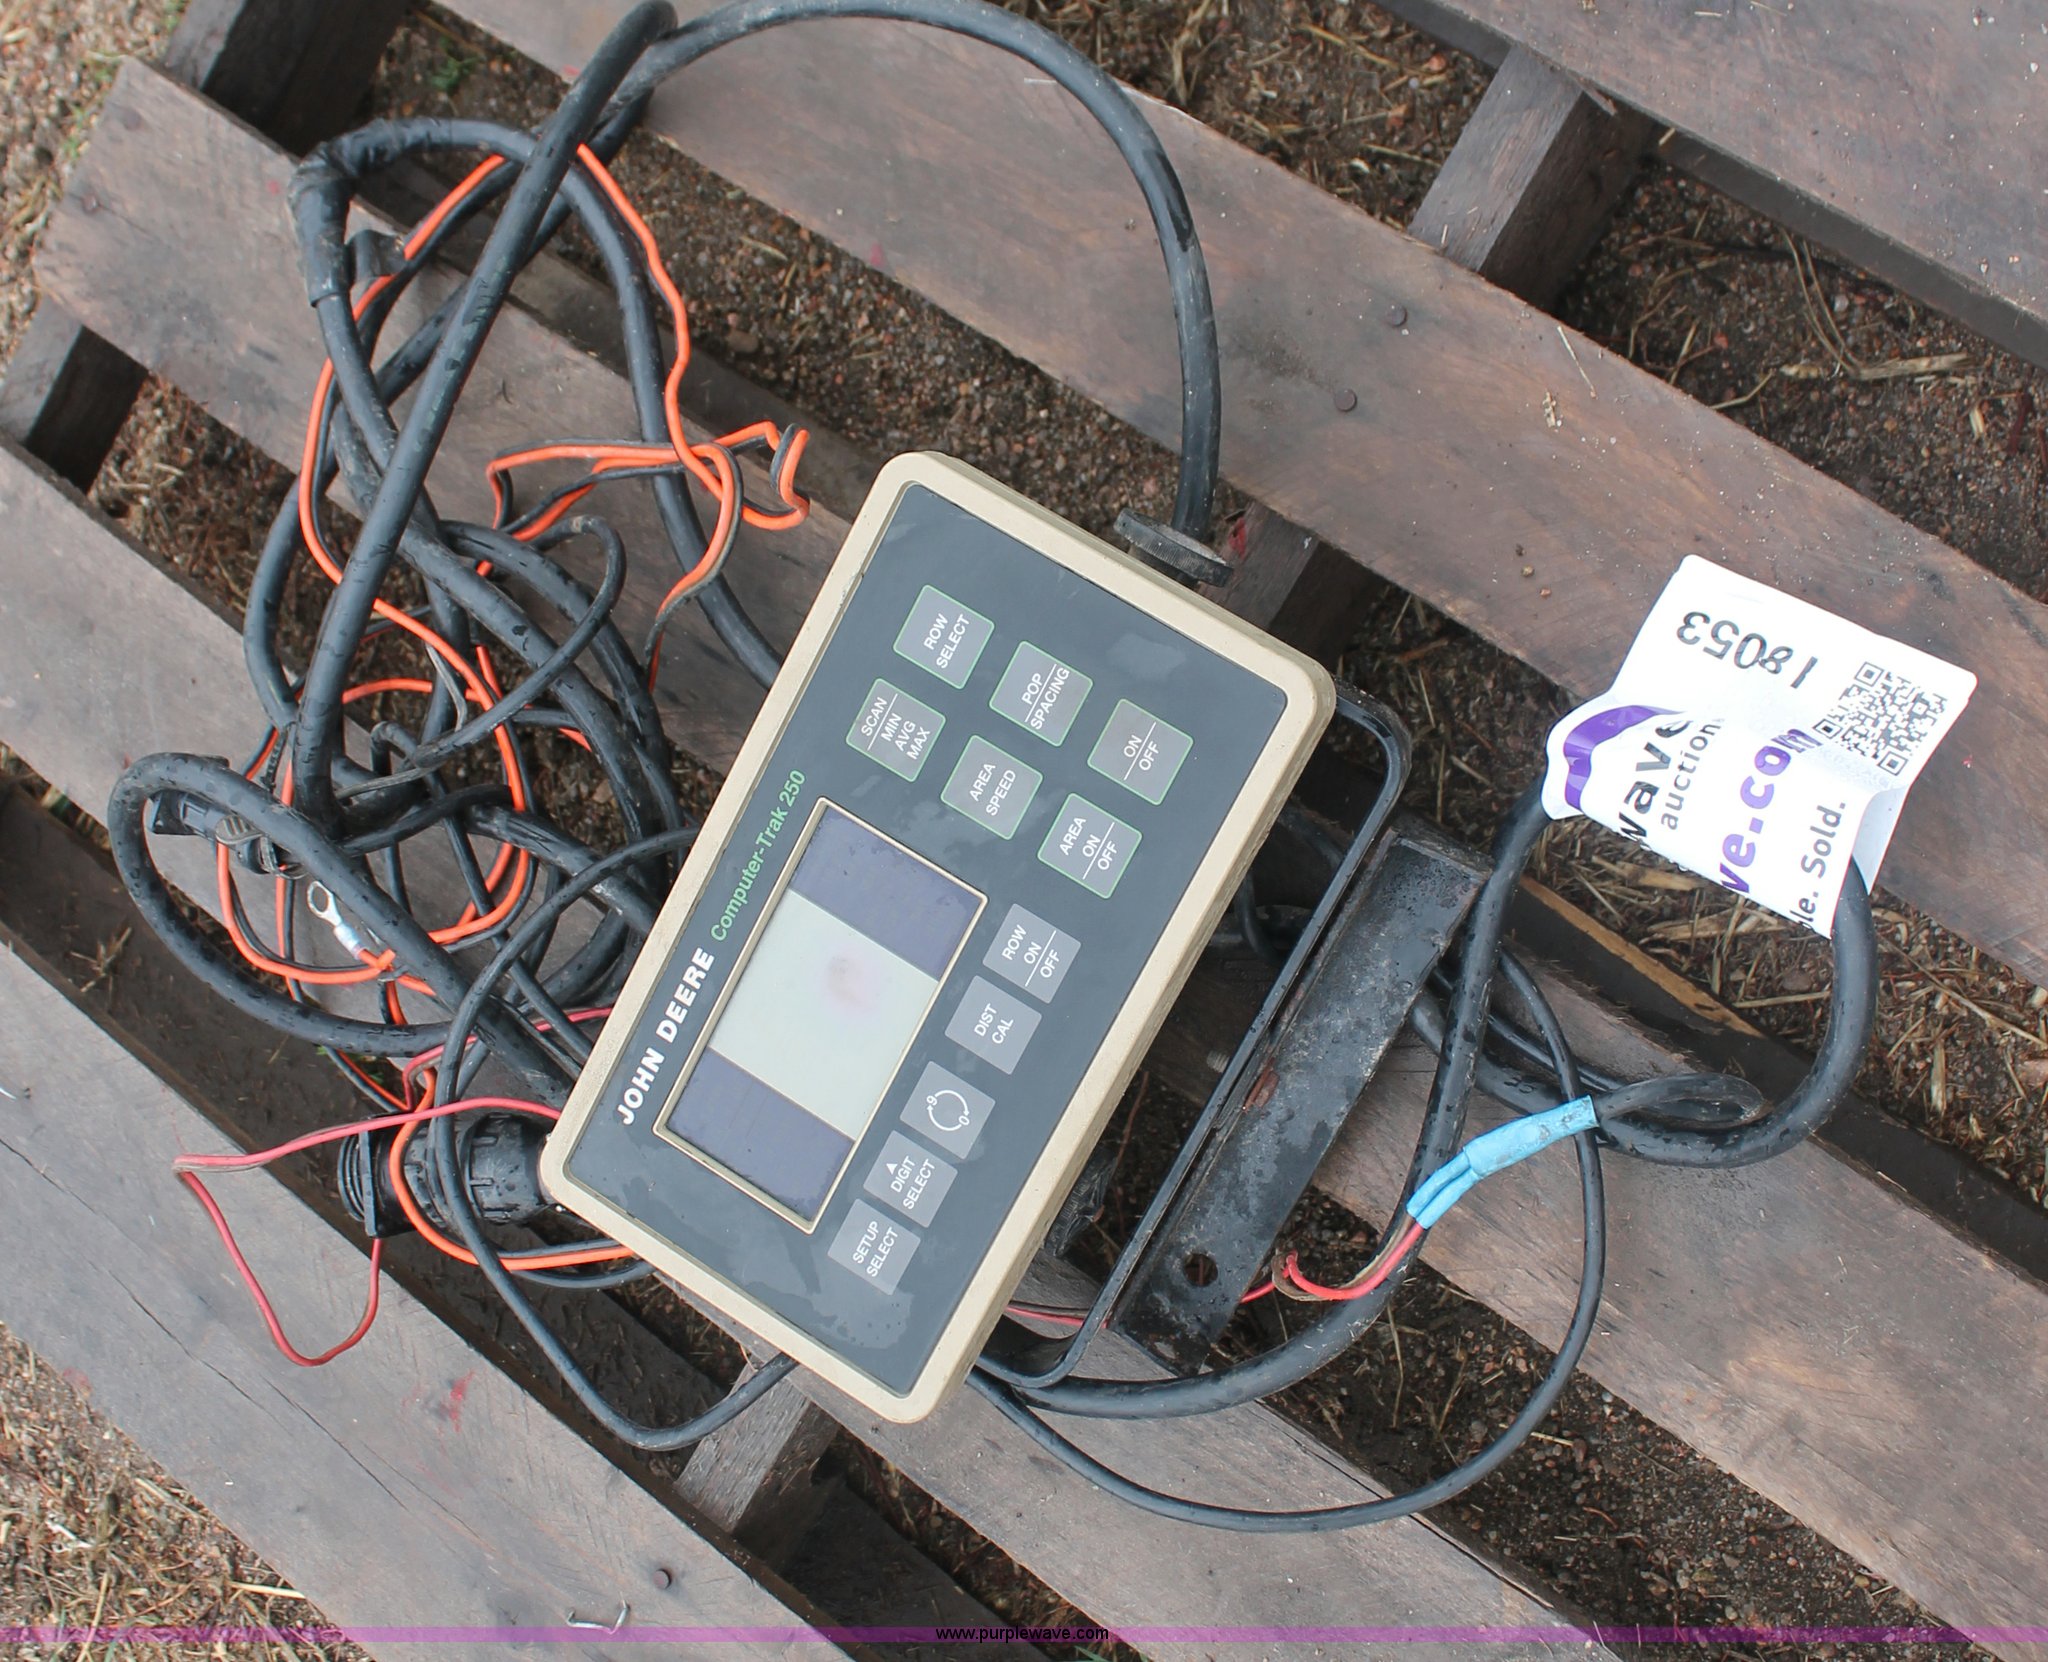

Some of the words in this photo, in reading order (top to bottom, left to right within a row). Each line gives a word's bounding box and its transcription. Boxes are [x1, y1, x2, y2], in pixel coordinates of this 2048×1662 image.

[924, 613, 948, 650] ROW
[936, 614, 970, 669] SELECT
[1675, 611, 1818, 690] 18053
[1021, 672, 1044, 706] POP
[1030, 667, 1070, 730] SPACING
[861, 697, 888, 737] SCAN
[880, 713, 902, 742] MIN
[894, 720, 916, 752] AVG
[906, 726, 931, 760] MAX
[1123, 734, 1142, 759] ON
[1138, 741, 1160, 772] OFF
[968, 762, 996, 802] AREA
[985, 769, 1016, 816] SPEED
[1058, 816, 1086, 856] AREA
[1082, 834, 1102, 858] ON
[1801, 802, 1846, 878] Sold.
[1097, 840, 1120, 871] OFF
[617, 1047, 665, 1126] JOHN
[656, 947, 715, 1044] DEERE
[710, 806, 788, 942] Computer-Trak
[778, 769, 806, 809] 250
[1002, 924, 1027, 960] ROW
[1024, 942, 1042, 964] ON
[1040, 950, 1061, 979] OFF
[974, 1003, 998, 1038] DIST
[992, 1016, 1014, 1044] CAL
[890, 1155, 916, 1193] DIGIT
[904, 1159, 936, 1210] SELECT
[852, 1220, 880, 1264] SETUP
[866, 1226, 899, 1278] SELECT
